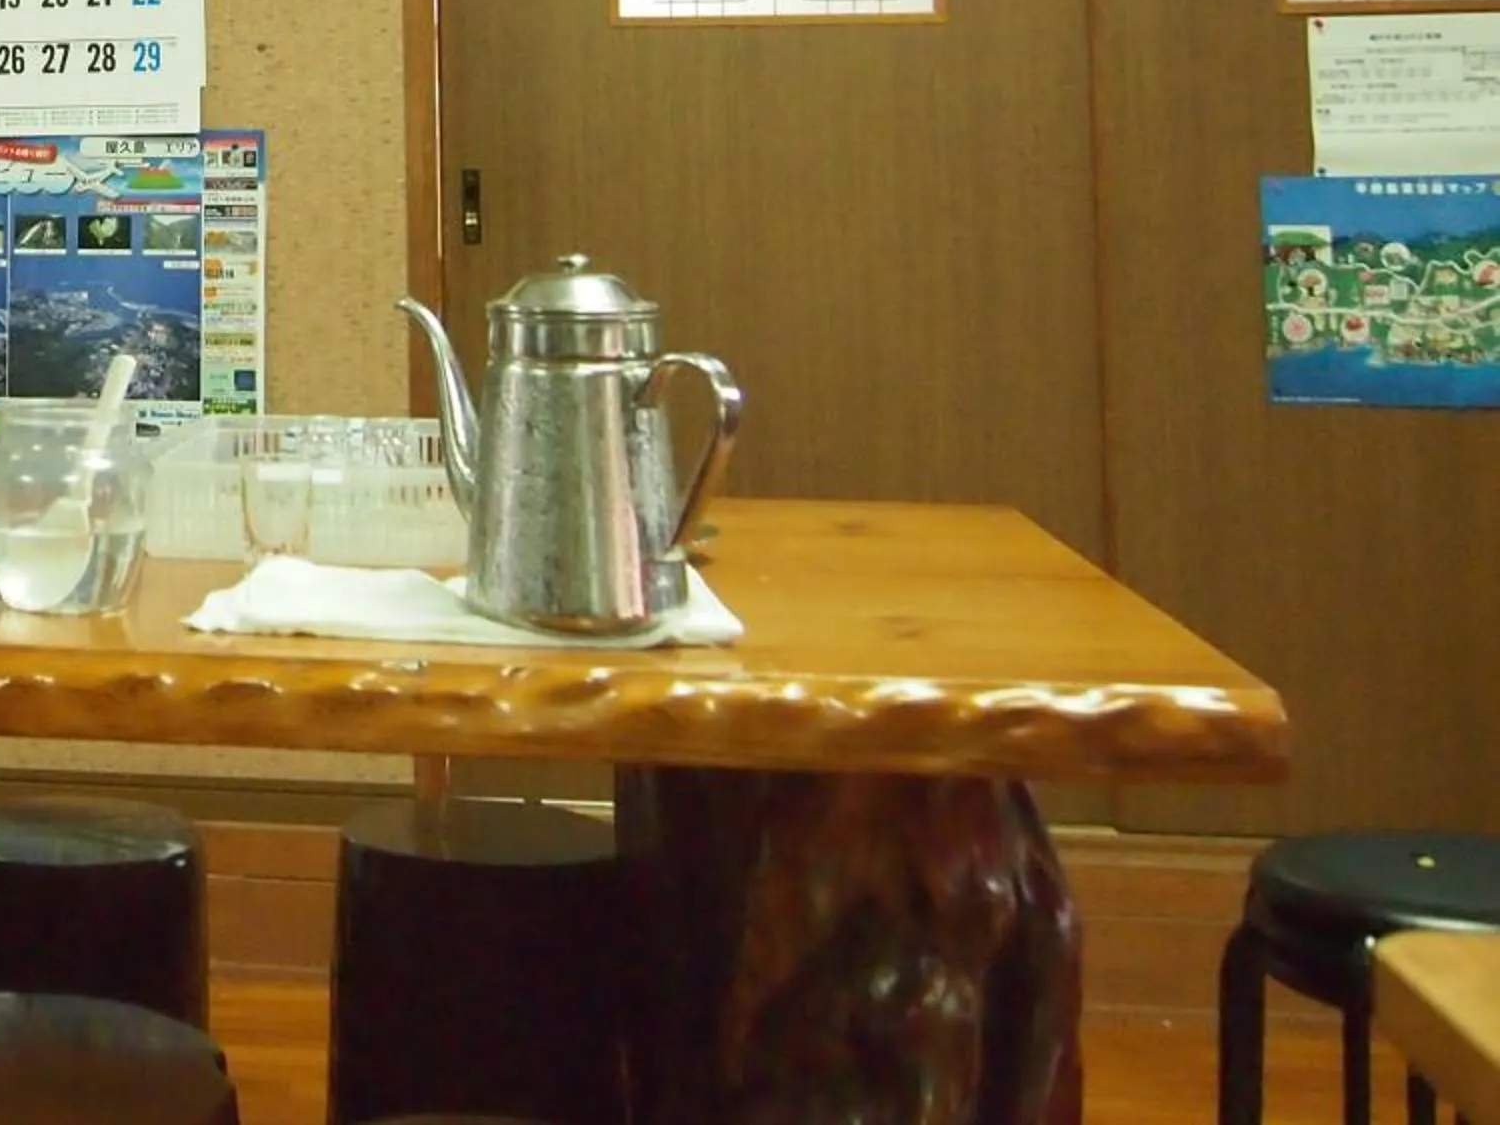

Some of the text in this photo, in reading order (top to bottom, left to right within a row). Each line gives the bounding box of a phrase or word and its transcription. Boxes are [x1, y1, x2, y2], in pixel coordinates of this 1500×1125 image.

[42, 43, 70, 73] 27
[86, 43, 116, 72] 28
[133, 42, 161, 72] 29
